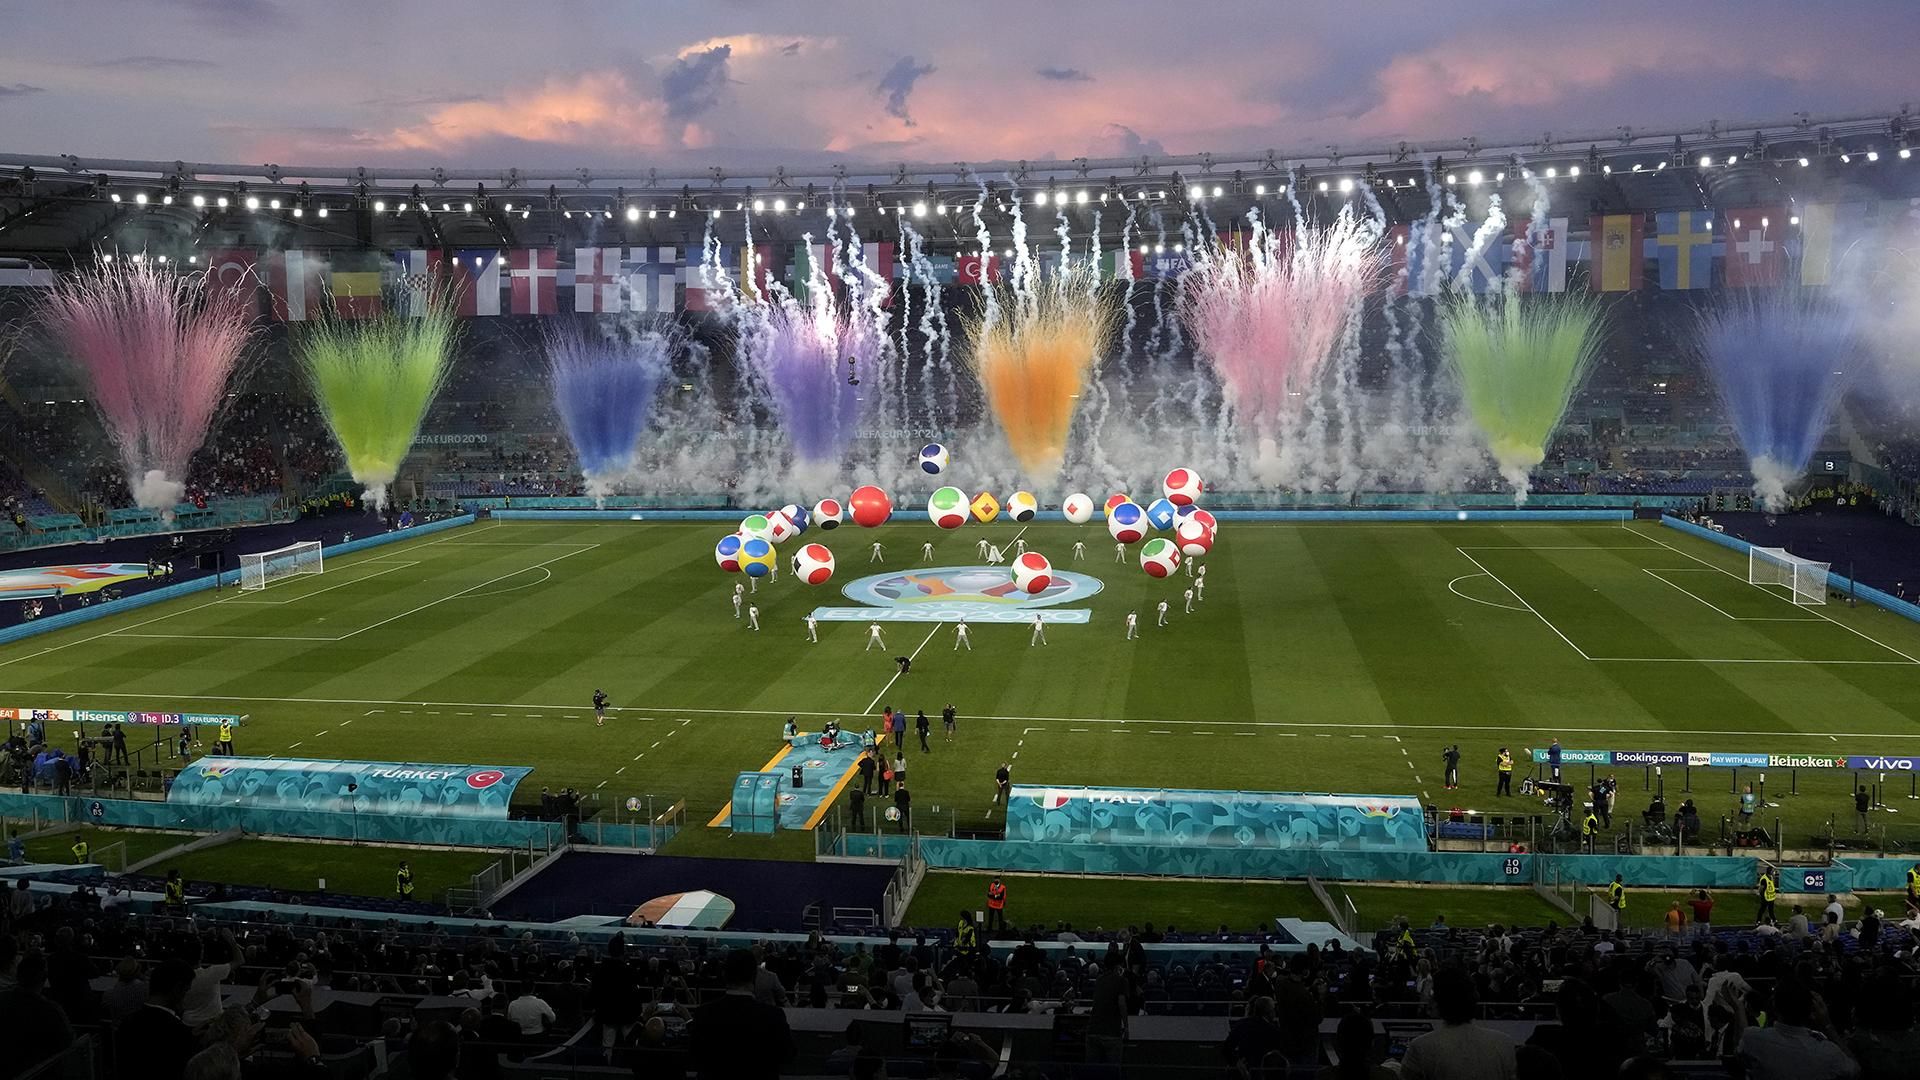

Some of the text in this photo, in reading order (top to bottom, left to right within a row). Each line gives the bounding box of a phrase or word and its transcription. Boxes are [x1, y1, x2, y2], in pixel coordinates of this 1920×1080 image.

[413, 434, 433, 444] EFA
[434, 434, 461, 444] EURO
[881, 429, 911, 439] EURO
[33, 709, 61, 720] FedEx
[76, 710, 125, 722] Hisense
[140, 713, 179, 724] The ID.3
[1616, 752, 1683, 764] Booking.com
[1690, 755, 1709, 763] Alipay
[1768, 755, 1833, 768] Heineken
[1864, 756, 1913, 770] vivo
[372, 769, 456, 780] TURKEY
[1088, 795, 1153, 805] ITALY
